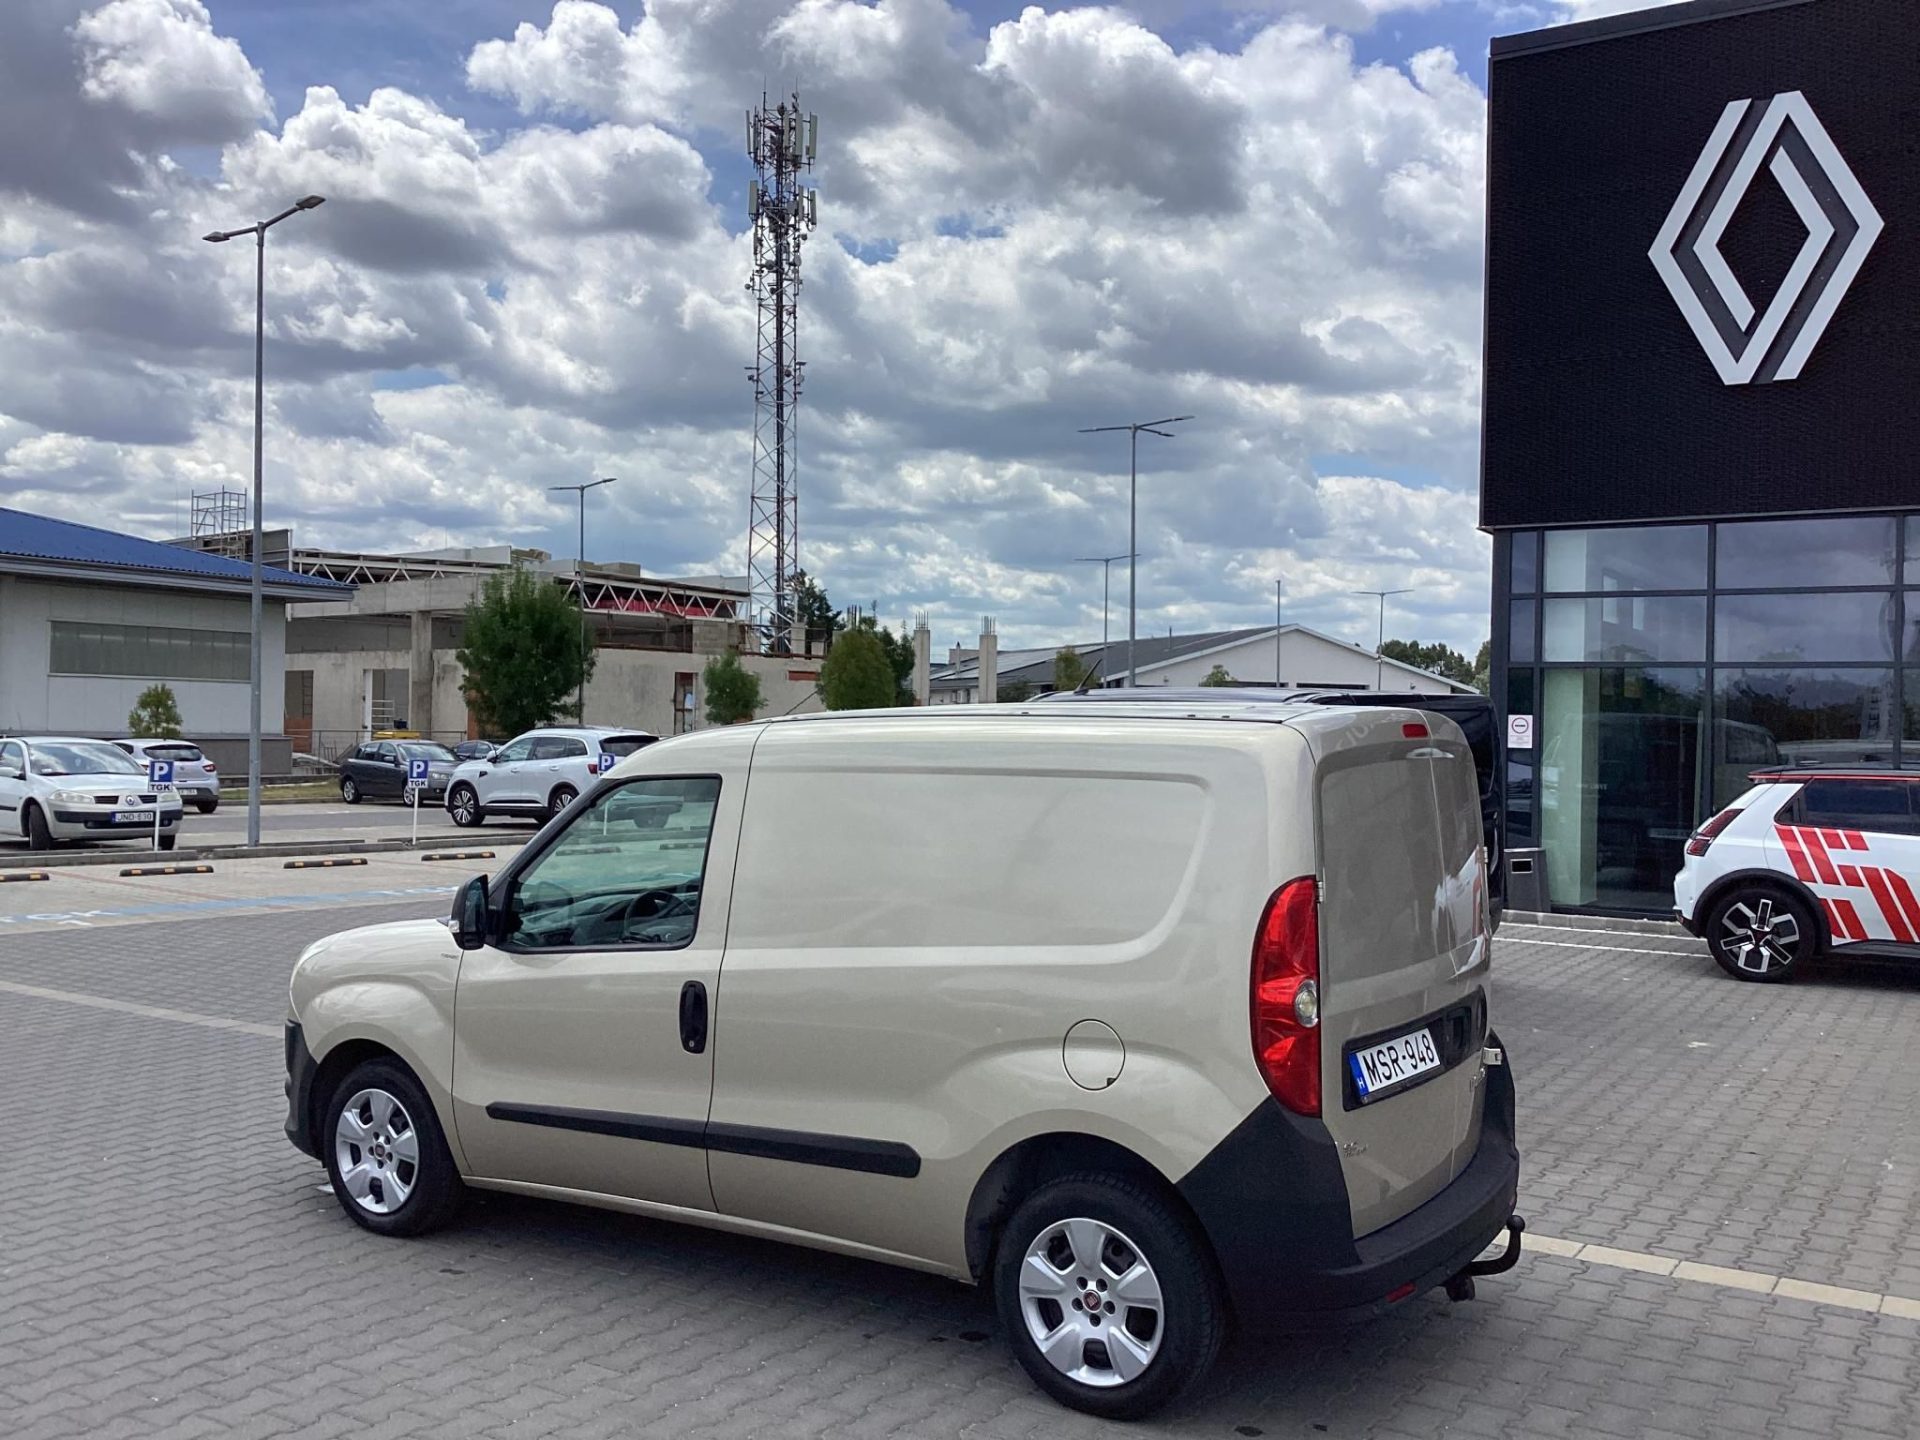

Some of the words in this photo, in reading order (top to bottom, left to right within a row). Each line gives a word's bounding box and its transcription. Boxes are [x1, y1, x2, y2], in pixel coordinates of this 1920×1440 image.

[412, 761, 425, 777] P
[601, 755, 612, 770] P
[153, 762, 169, 780] P
[1362, 1034, 1435, 1086] MSR-948
[1357, 1077, 1365, 1088] H
